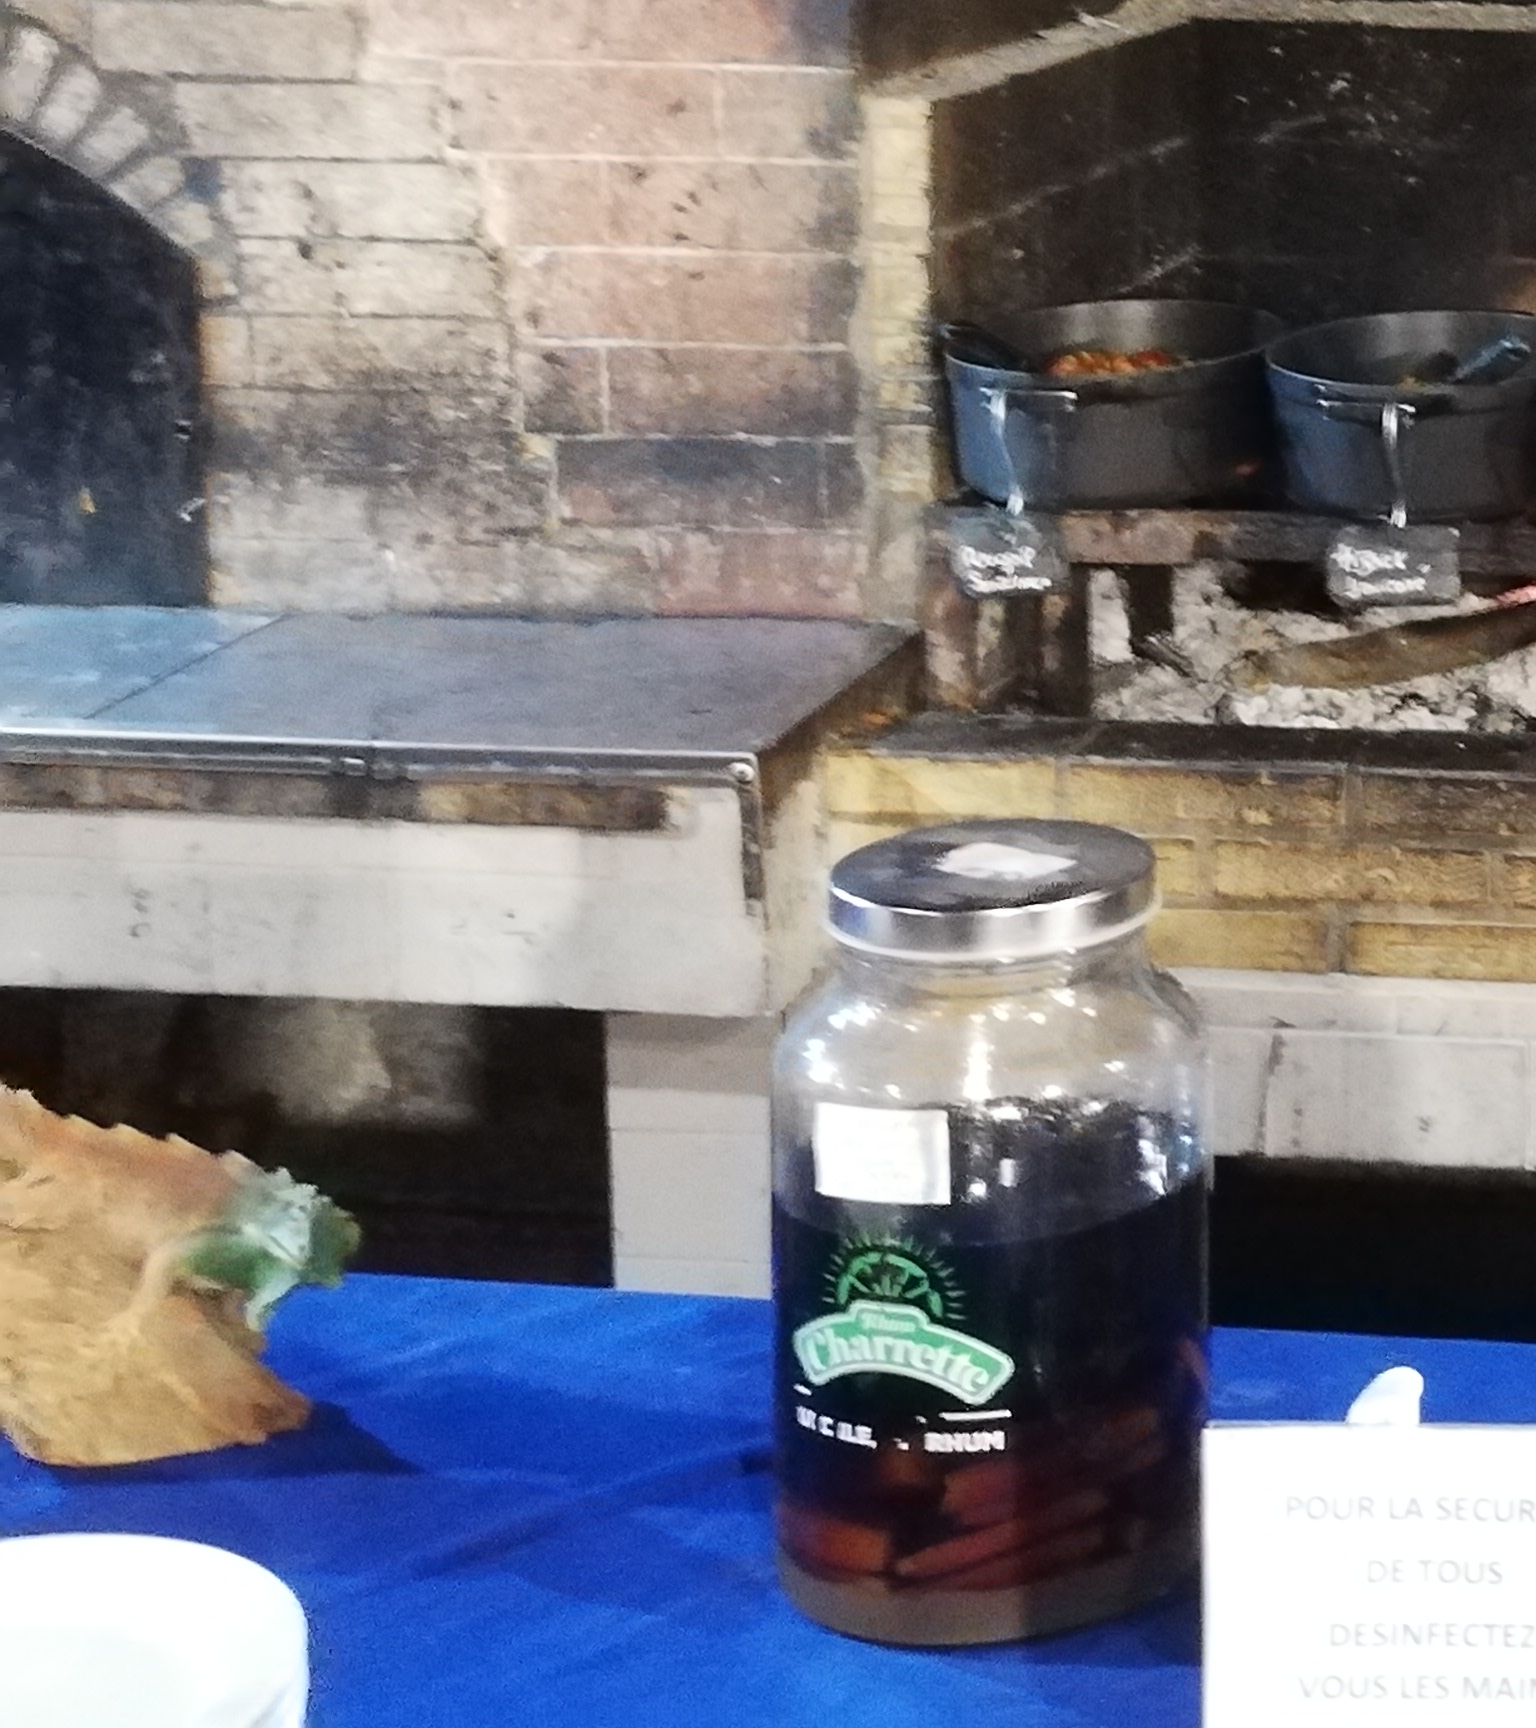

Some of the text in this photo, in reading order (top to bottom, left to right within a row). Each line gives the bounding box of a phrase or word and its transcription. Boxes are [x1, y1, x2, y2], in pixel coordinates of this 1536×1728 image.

[805, 1327, 989, 1392] Charrette
[1284, 1495, 1375, 1521] POUR
[1388, 1496, 1424, 1520] LA
[1366, 1559, 1503, 1585] DE TOUS
[1299, 1675, 1389, 1699] VOUS
[1400, 1675, 1451, 1700] LES
